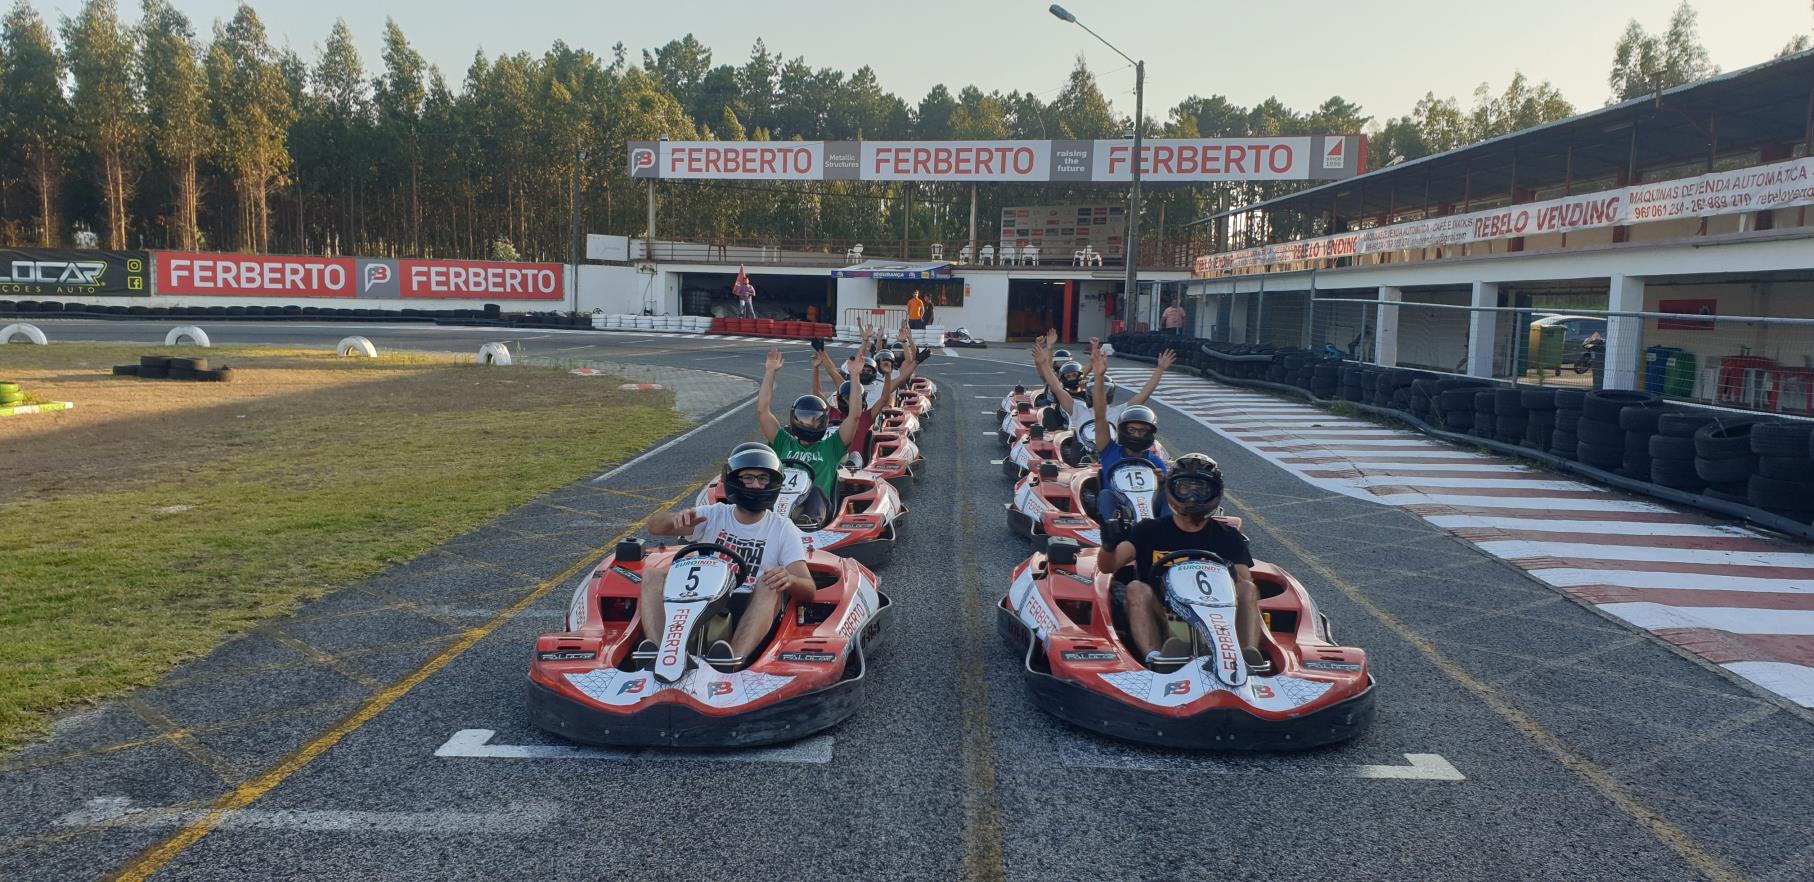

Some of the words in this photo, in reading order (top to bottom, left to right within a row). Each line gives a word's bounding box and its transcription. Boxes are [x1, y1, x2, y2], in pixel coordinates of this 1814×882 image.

[671, 148, 812, 173] FERBERTO
[825, 161, 859, 169] Structures
[875, 147, 1033, 175] FERBERTO
[1056, 150, 1087, 158] raising
[1064, 157, 1079, 165] the
[1108, 144, 1292, 175] FERBERTO
[1474, 210, 1529, 239] REBELO
[1536, 196, 1620, 231] VENDING
[170, 259, 346, 291] FERBERTO
[411, 265, 556, 294] FERBERTO
[56, 286, 95, 294] AUTO
[1125, 471, 1145, 487] 15
[674, 560, 718, 569] EUROINDY
[1178, 564, 1221, 572] EUROINDY
[685, 566, 701, 591] 5
[1195, 570, 1213, 596] 6
[1025, 595, 1059, 637] FERBERT
[662, 608, 691, 667] FERBERTO
[1208, 613, 1239, 672] FERBERTO
